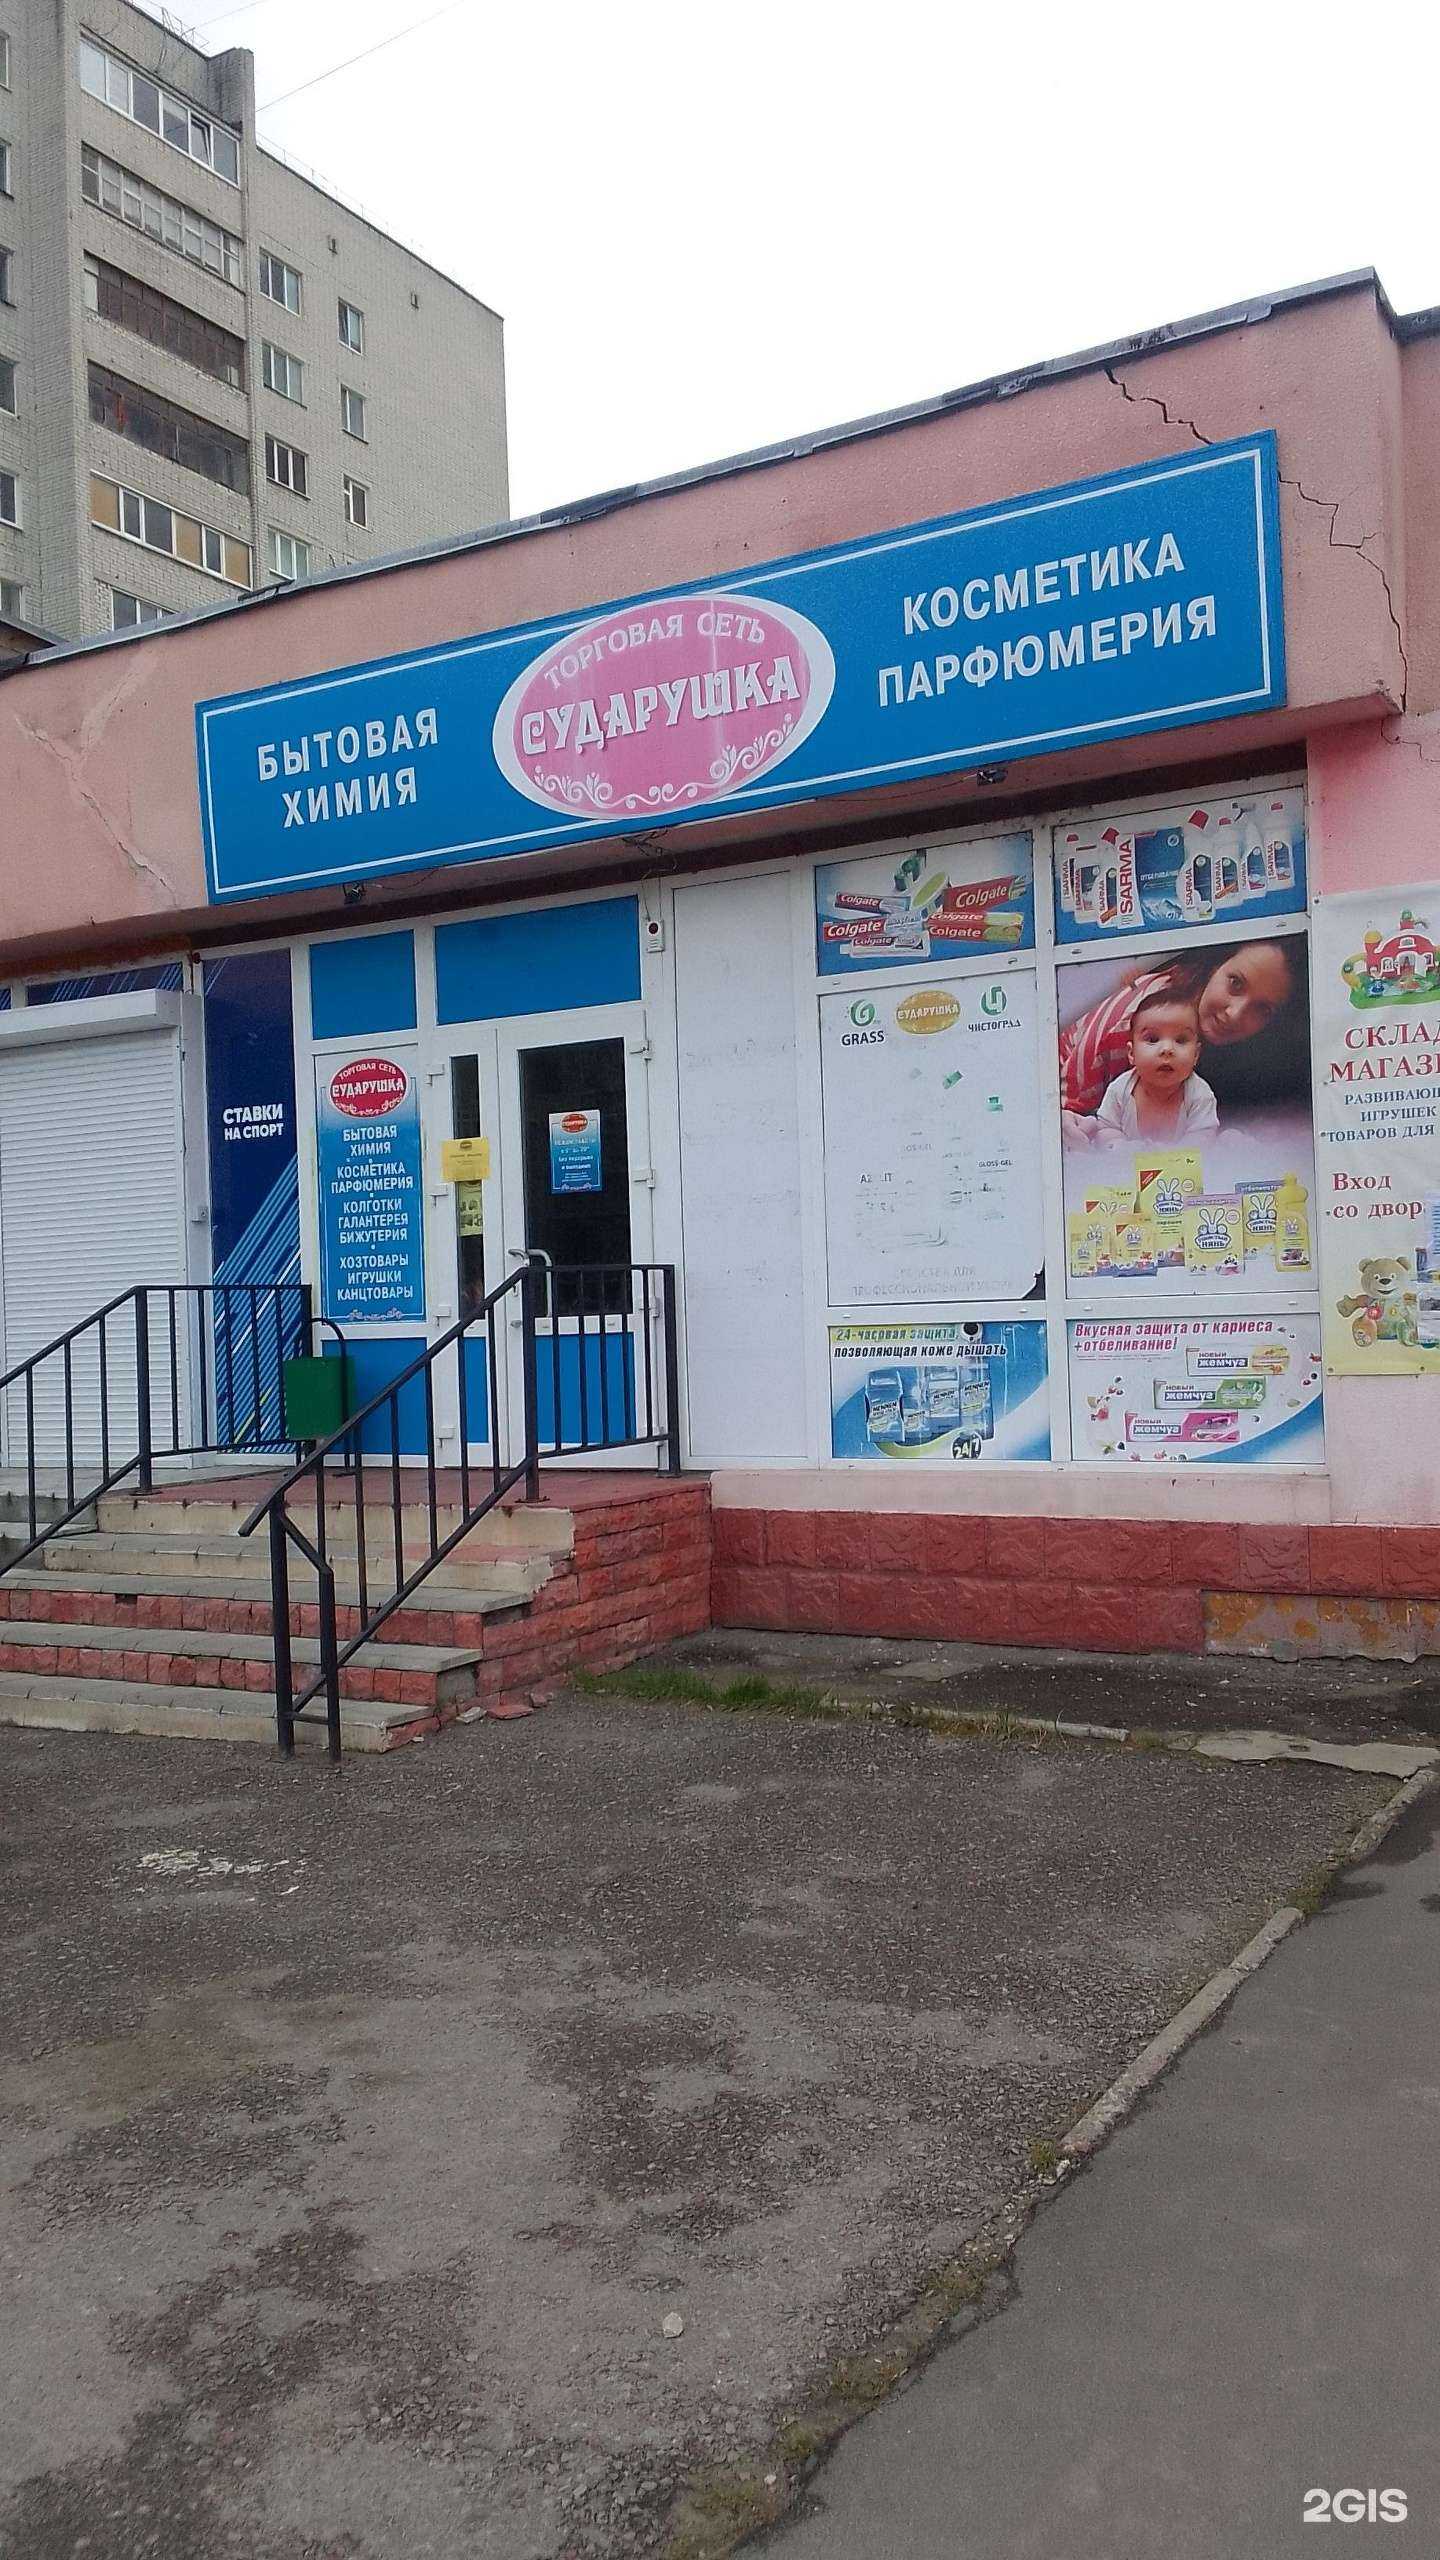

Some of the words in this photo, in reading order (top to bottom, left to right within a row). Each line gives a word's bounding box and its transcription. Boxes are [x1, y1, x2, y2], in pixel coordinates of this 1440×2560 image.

[903, 533, 1186, 635] КОСМЕТИКА
[544, 614, 684, 689] ТОРГОВАЯ
[697, 612, 765, 644] СЕТЬ
[878, 595, 1216, 707] ПАРФЮМЕРИЯ
[520, 654, 801, 757] СУДАРУШКА
[257, 707, 440, 783] БЫТОВАЯ
[281, 767, 418, 829] ХИМИЯ
[1119, 840, 1133, 914] SARMA
[1185, 868, 1193, 906] SARMA
[840, 894, 879, 906] Colgate
[956, 884, 1008, 908] Colgate
[931, 913, 983, 921] Colgate
[827, 920, 882, 937] Colgate
[929, 926, 981, 938] Colgate
[853, 937, 892, 945] Colgate
[968, 1019, 1021, 1032] ЧИСТОГРАД
[841, 1030, 885, 1046] GRASS
[339, 1063, 376, 1080] ТОРГОВАЯ
[379, 1063, 397, 1075] СЕТЬ
[332, 1078, 404, 1099] СУДАРУШКА
[223, 1103, 283, 1125] СТАВКИ
[1360, 1106, 1437, 1122] ИГРУШЕК
[224, 1127, 241, 1141] НА
[243, 1123, 284, 1139] СПОРТ
[343, 1125, 397, 1141] БЫТОВАЯ
[1327, 1127, 1397, 1142] ТОВАРОВ
[1402, 1124, 1435, 1139] ДЛЯ
[350, 1142, 391, 1157] ХИМИЯ
[337, 1162, 406, 1179] КОСМЕТИКА
[331, 1176, 414, 1194] ПАРФЮМЕРИЯ
[1333, 1173, 1391, 1191] Вход
[343, 1198, 402, 1213] КОЛГОТКИ
[1333, 1205, 1358, 1218] со
[1368, 1201, 1426, 1219] двор
[338, 1213, 408, 1229] ГАЛАНТЕРЕЯ
[340, 1228, 408, 1244] БИЖУТЕРИЯ
[340, 1254, 408, 1269] ХОЗТОВАРЫ
[348, 1270, 402, 1284] ИГРУШКИ
[337, 1286, 413, 1302] КАНЦТОВАРЫ
[836, 1328, 906, 1341] 24-часовая
[1075, 1323, 1131, 1338] Вкусная
[1136, 1323, 1187, 1337] защита
[1192, 1322, 1207, 1334] от
[1213, 1320, 1273, 1335] кариеса
[834, 1345, 917, 1358] позволяющая
[921, 1344, 953, 1357] коже
[956, 1343, 1006, 1357] дышать
[1074, 1337, 1178, 1352] +отбеливание!
